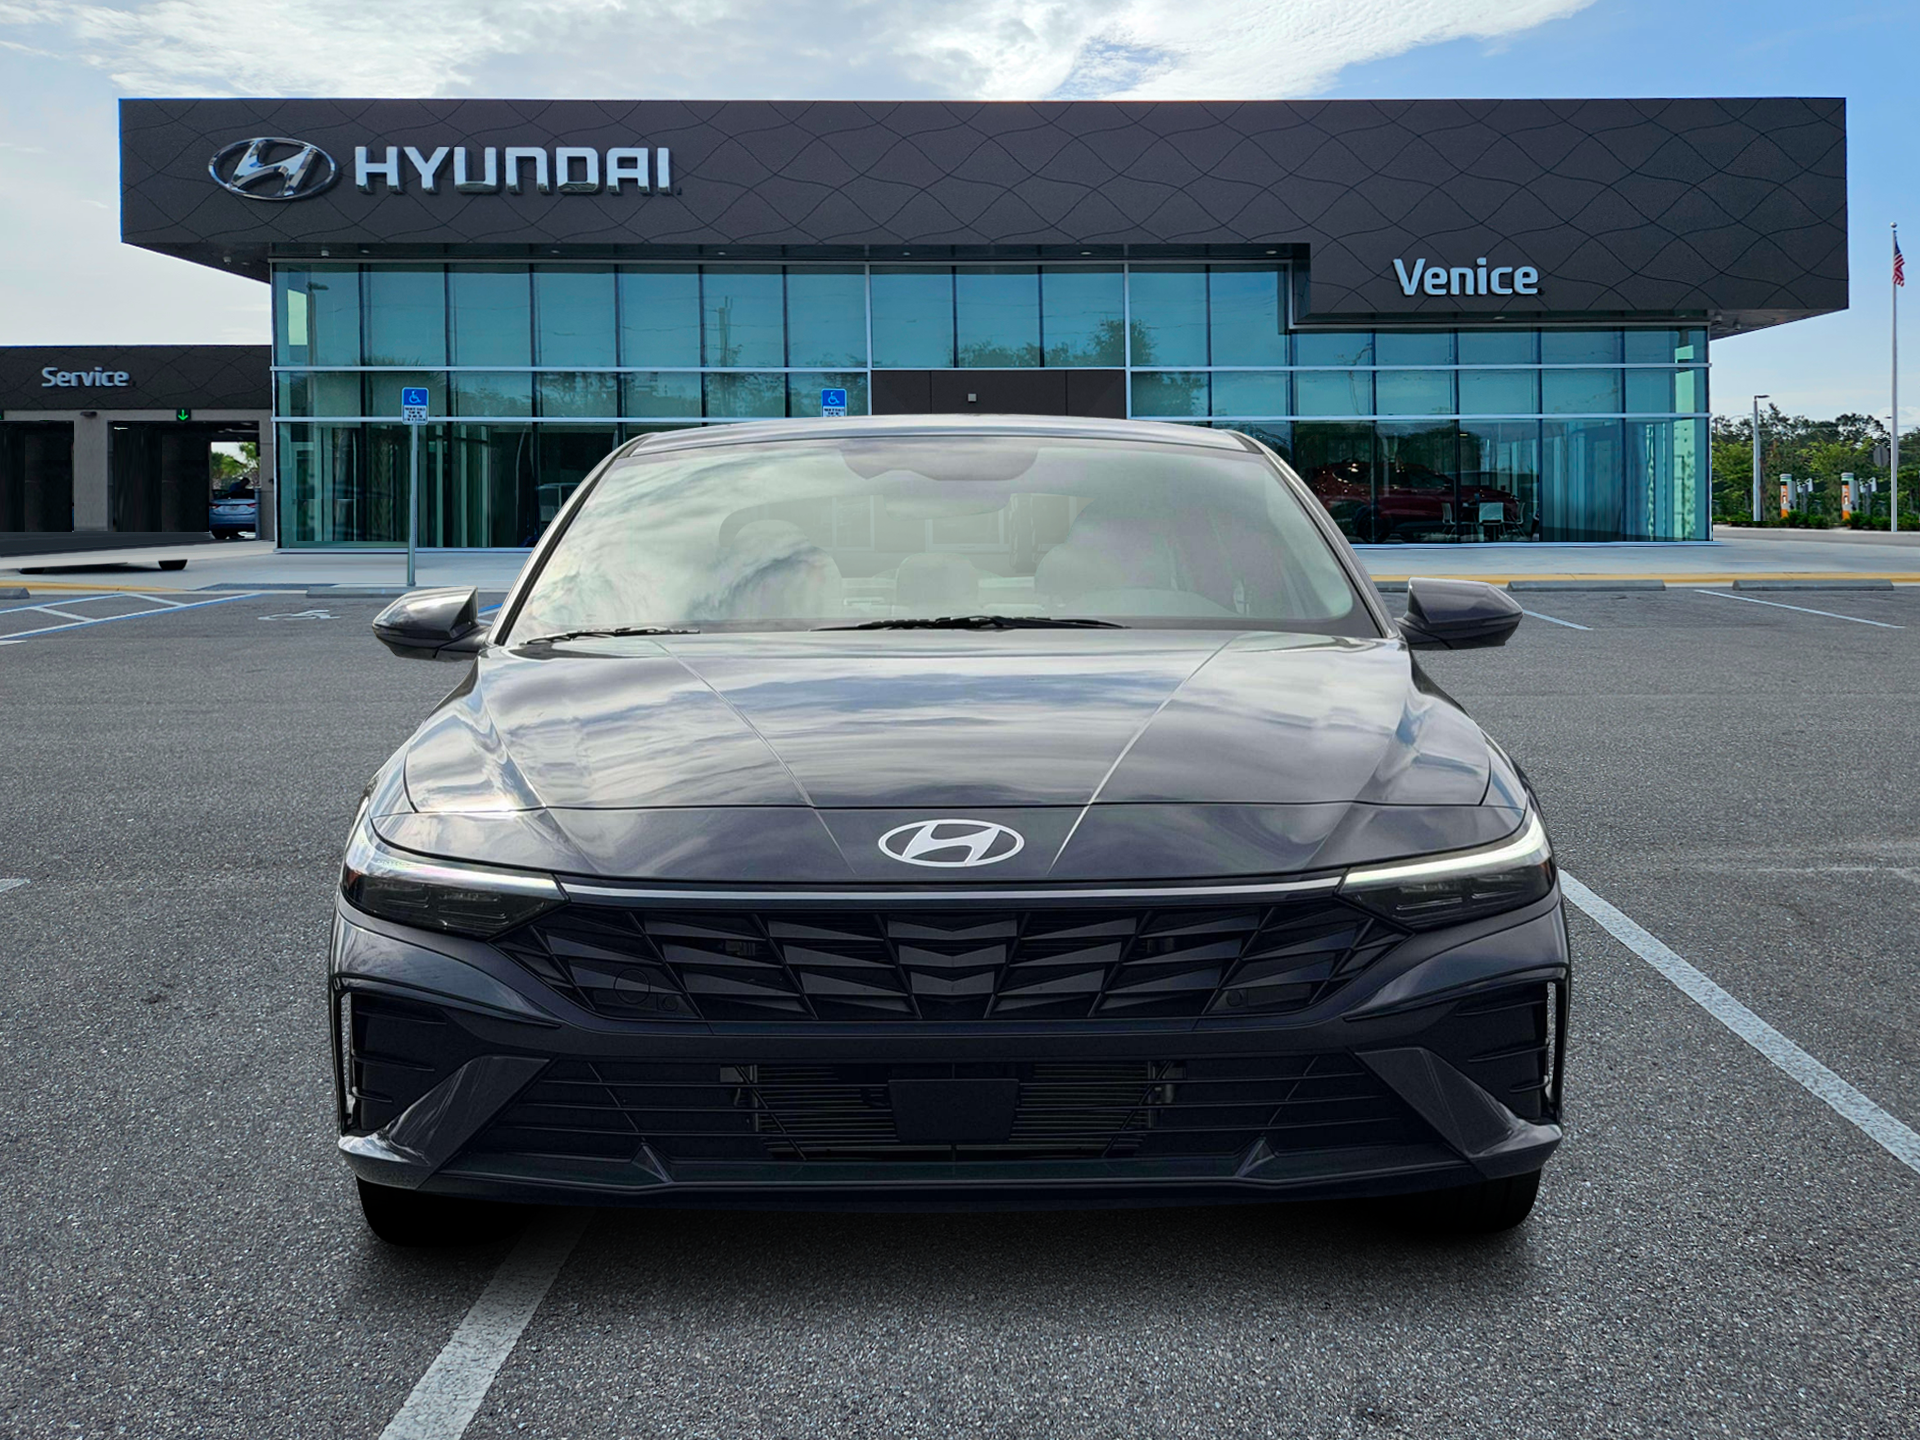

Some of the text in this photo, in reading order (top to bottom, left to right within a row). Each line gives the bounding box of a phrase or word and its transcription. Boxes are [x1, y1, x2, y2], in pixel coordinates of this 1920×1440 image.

[354, 146, 674, 194] HYUNDAI
[1393, 257, 1538, 296] Venice
[41, 366, 130, 387] Service
